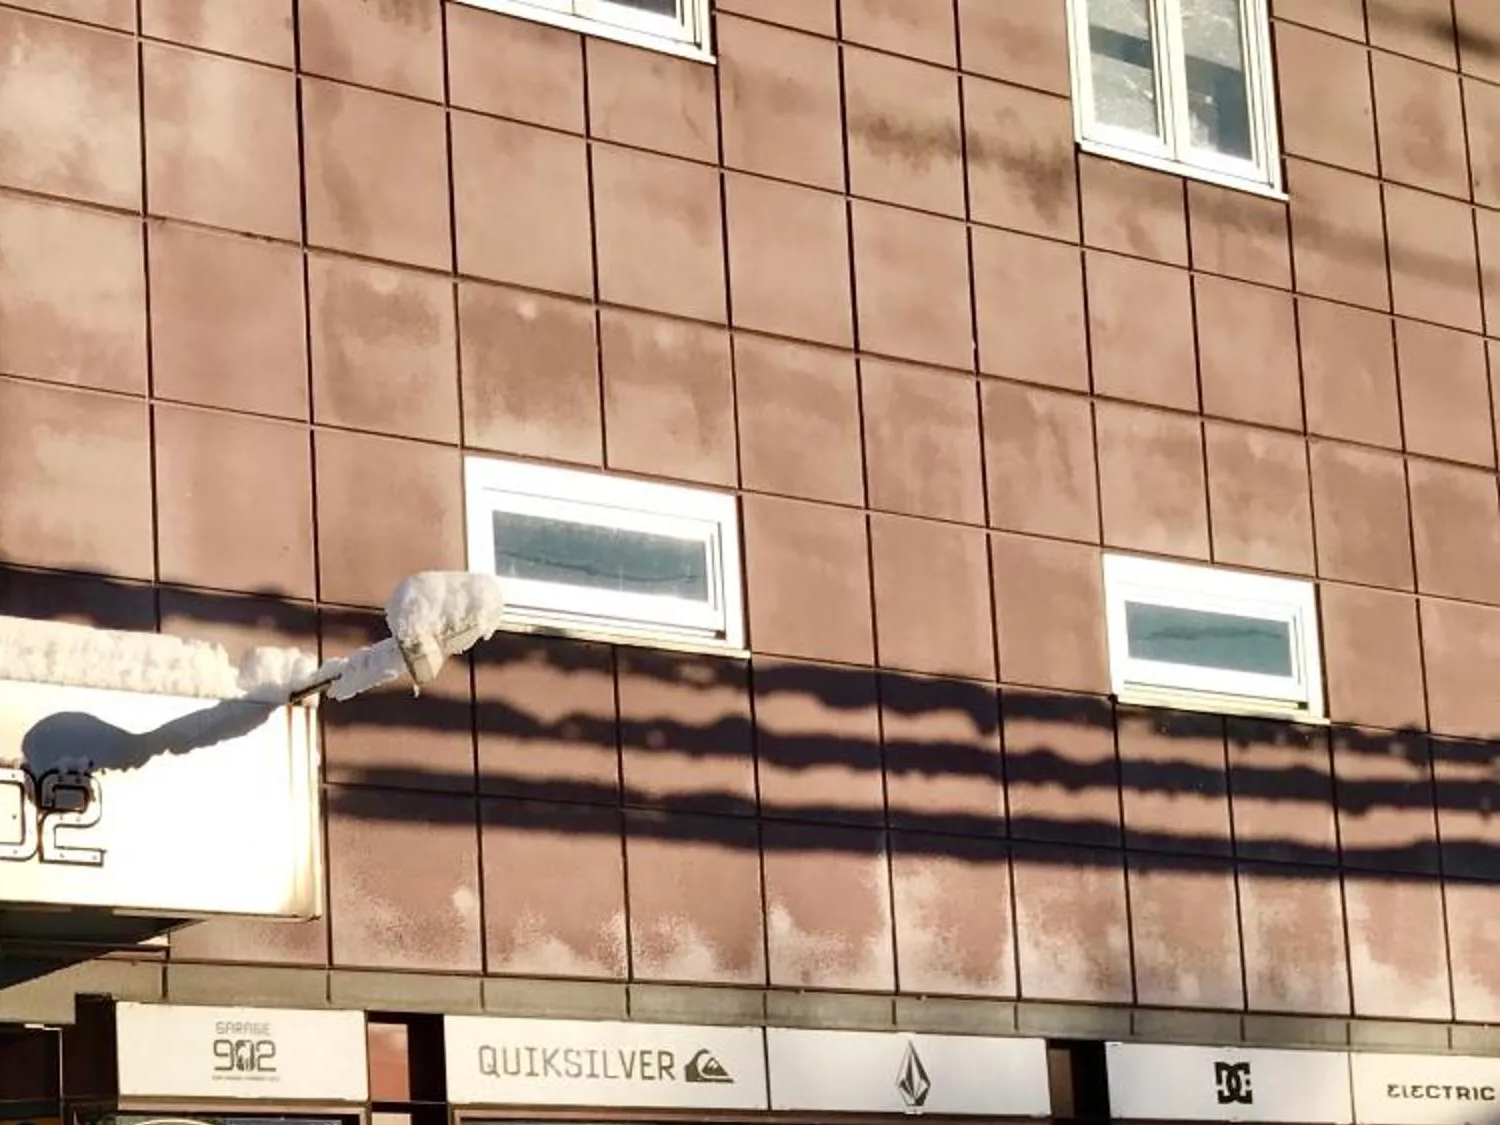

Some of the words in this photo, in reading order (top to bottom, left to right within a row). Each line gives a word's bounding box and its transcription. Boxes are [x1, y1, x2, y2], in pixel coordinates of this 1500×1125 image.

[214, 1020, 272, 1037] GARAGE
[212, 1039, 277, 1073] 902
[477, 1044, 676, 1084] QUIKSILVER
[1386, 1082, 1496, 1102] ELECTRIC
